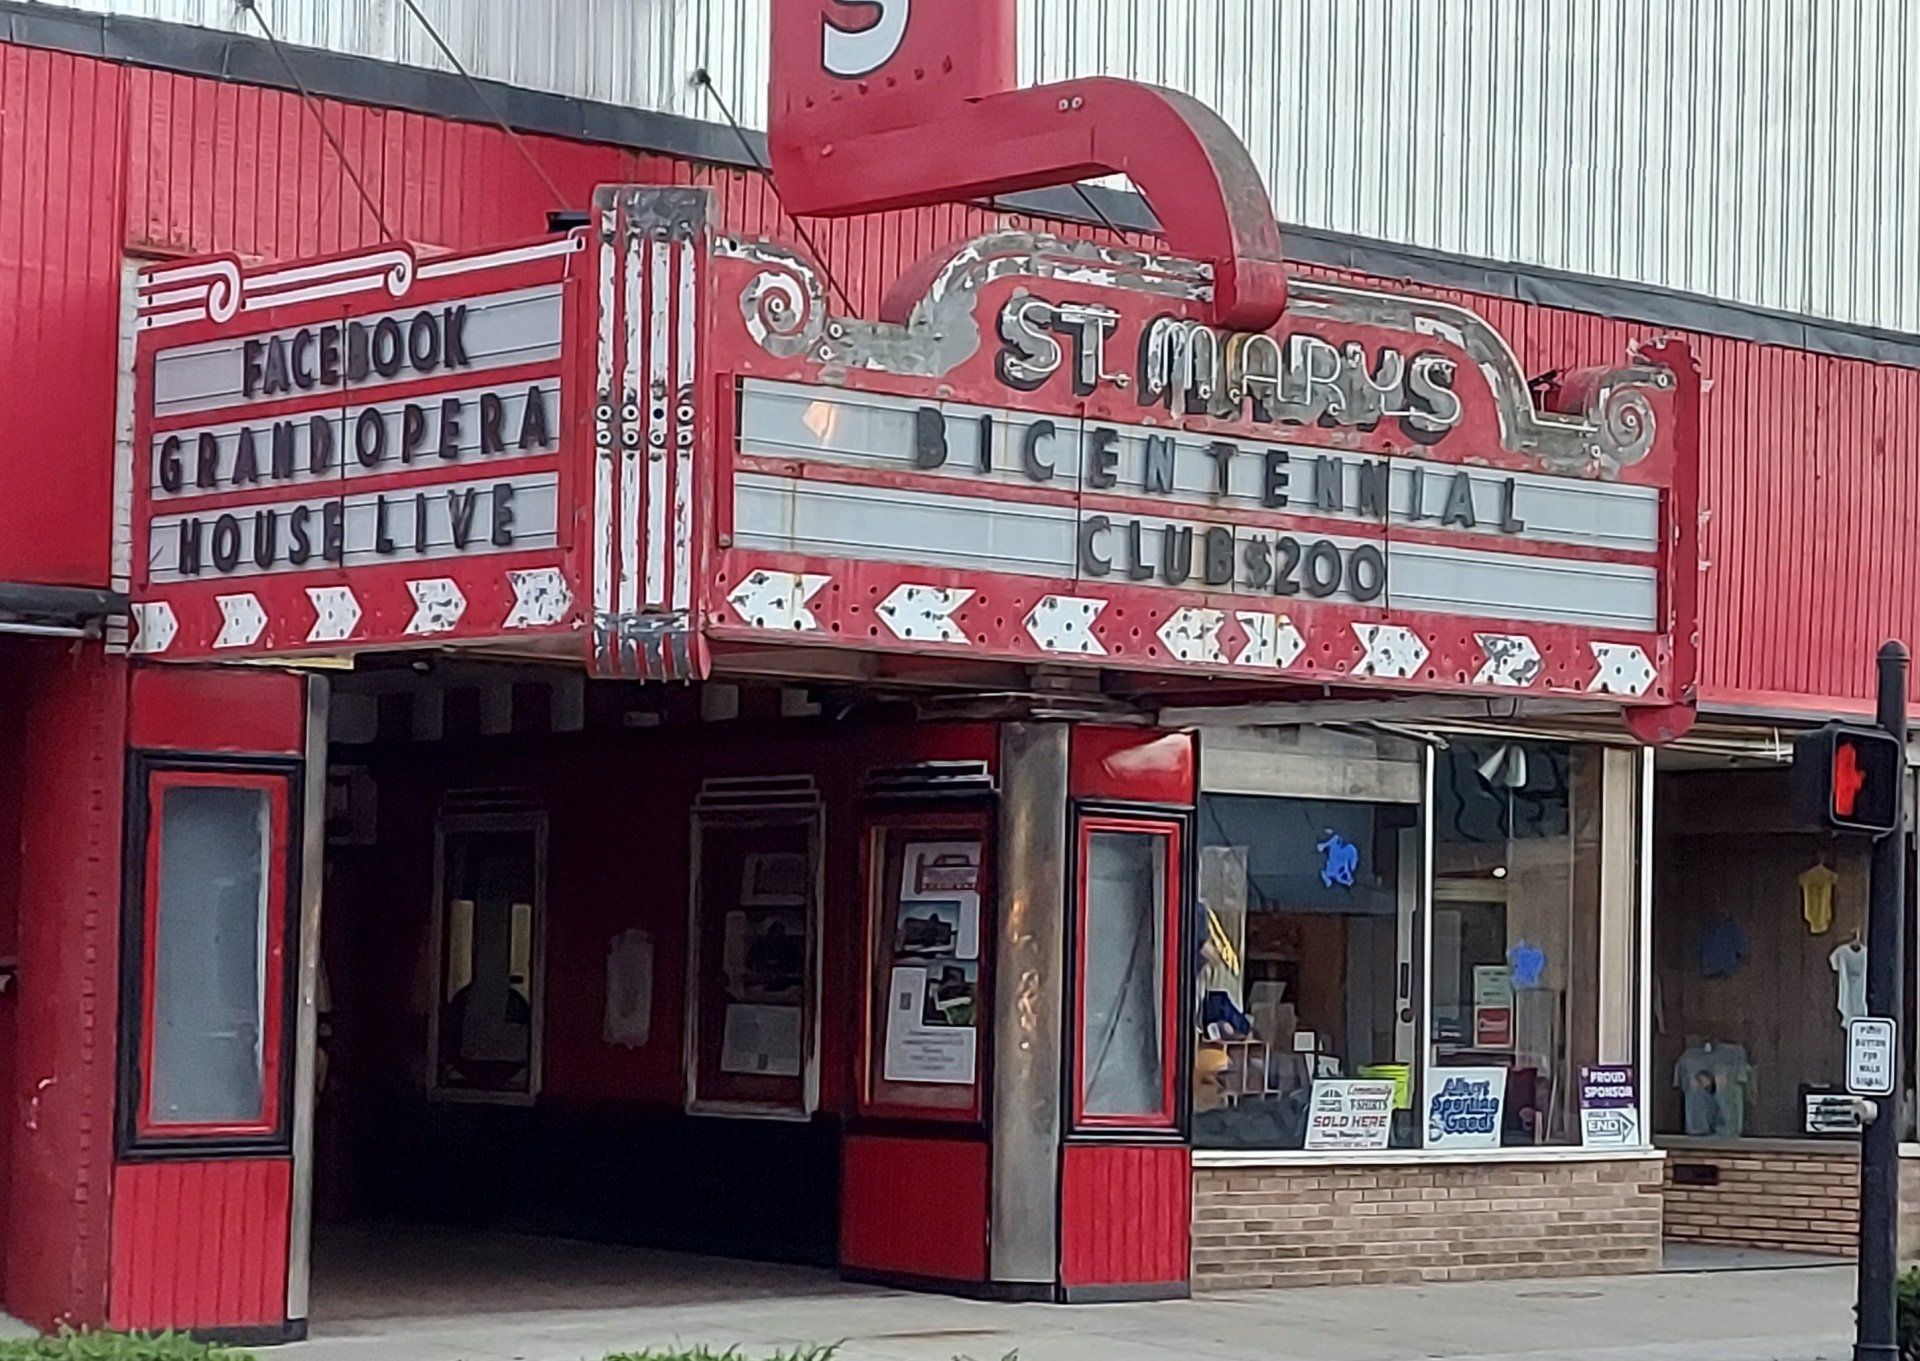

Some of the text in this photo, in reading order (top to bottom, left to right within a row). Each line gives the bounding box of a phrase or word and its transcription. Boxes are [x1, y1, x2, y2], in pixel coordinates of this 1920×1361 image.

[242, 304, 470, 398] FACEBOOK
[159, 386, 549, 493] GRAND OPERA
[916, 406, 1526, 535] BICENTENNIAL
[178, 483, 515, 575] HOUSE LIVE
[1078, 514, 1235, 587] CLUB
[1590, 1071, 1626, 1083] PROUD
[1584, 1086, 1634, 1098] SPONSOR
[1431, 1094, 1500, 1121] Sporting
[1312, 1115, 1388, 1128] SOLD HERE
[1444, 1111, 1495, 1135] Goods
[1588, 1120, 1619, 1131] END
